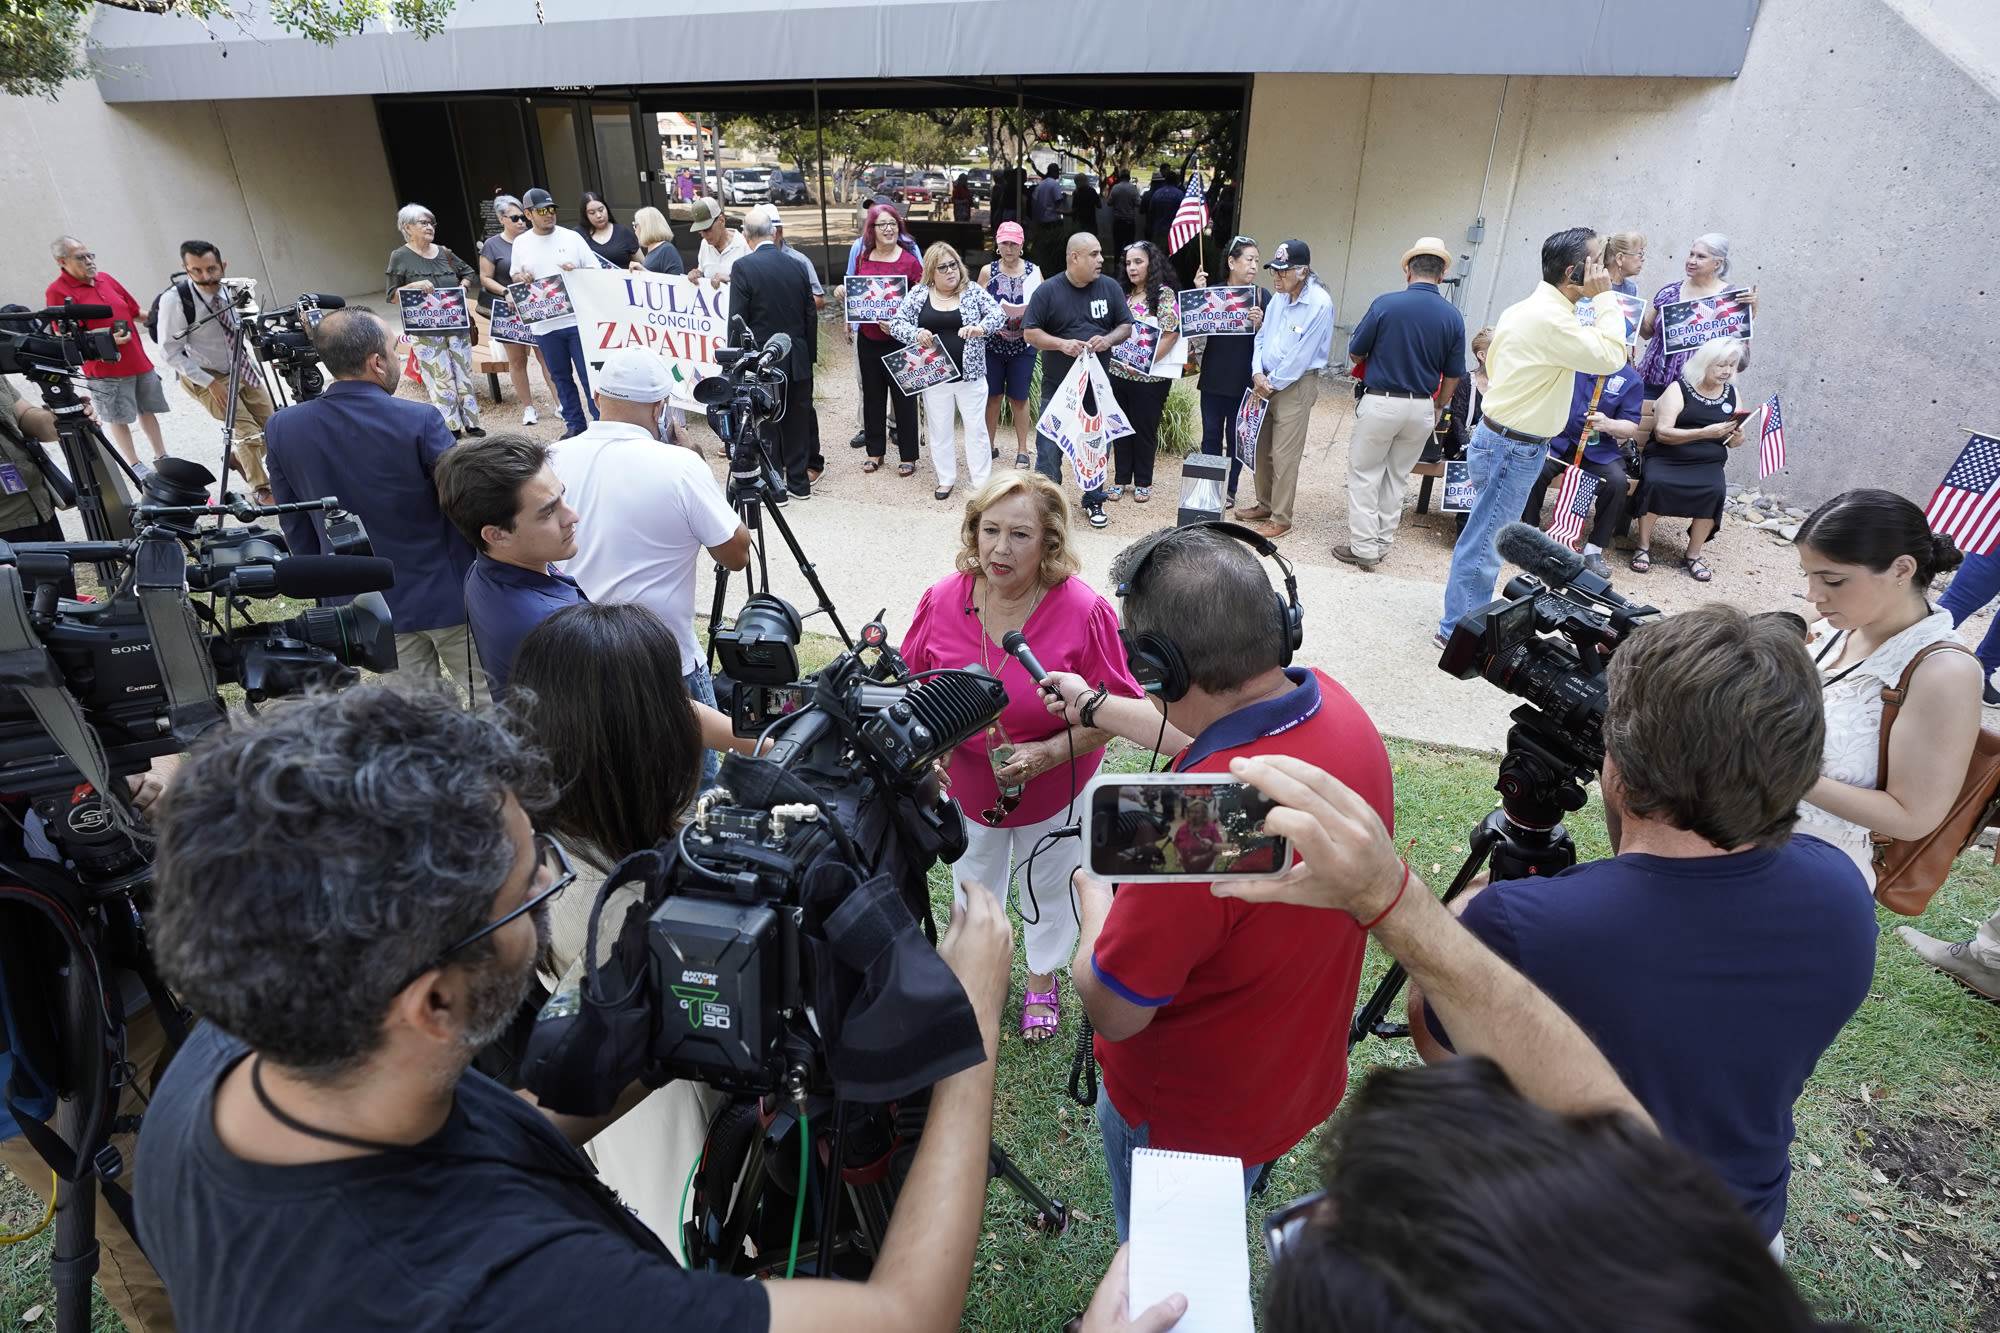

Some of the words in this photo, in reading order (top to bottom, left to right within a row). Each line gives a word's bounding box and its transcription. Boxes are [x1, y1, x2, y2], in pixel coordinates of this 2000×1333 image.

[520, 294, 566, 313] DEMOCRACY
[849, 299, 902, 309] DEMOCRACY
[406, 308, 463, 318] DEMOCRACY
[530, 311, 546, 320] FOR
[547, 305, 562, 316] ALL
[860, 310, 877, 319] FOR
[879, 310, 893, 318] ALL
[1185, 311, 1249, 323] DEMOCRACY
[417, 318, 437, 326] FOR
[439, 317, 455, 325] ALL
[647, 312, 712, 332] CONCILIO
[1196, 322, 1217, 332] FOR
[1219, 322, 1238, 330] ALL
[1668, 314, 1746, 338] DEMOCRACY
[503, 329, 520, 339] FOR
[1683, 333, 1707, 346] FOR
[1710, 328, 1732, 340] ALL
[1114, 348, 1129, 360] FOR
[1130, 354, 1142, 367] ALL
[897, 358, 947, 384] DEMOCRACY
[910, 377, 928, 389] FOR
[928, 369, 945, 383] ALL
[1083, 470, 1105, 489] WE
[111, 643, 152, 655] SONY
[126, 683, 158, 693] Exmor
[720, 831, 747, 840] SONY
[682, 969, 719, 980] ANTON
[702, 1014, 731, 1030] 90
